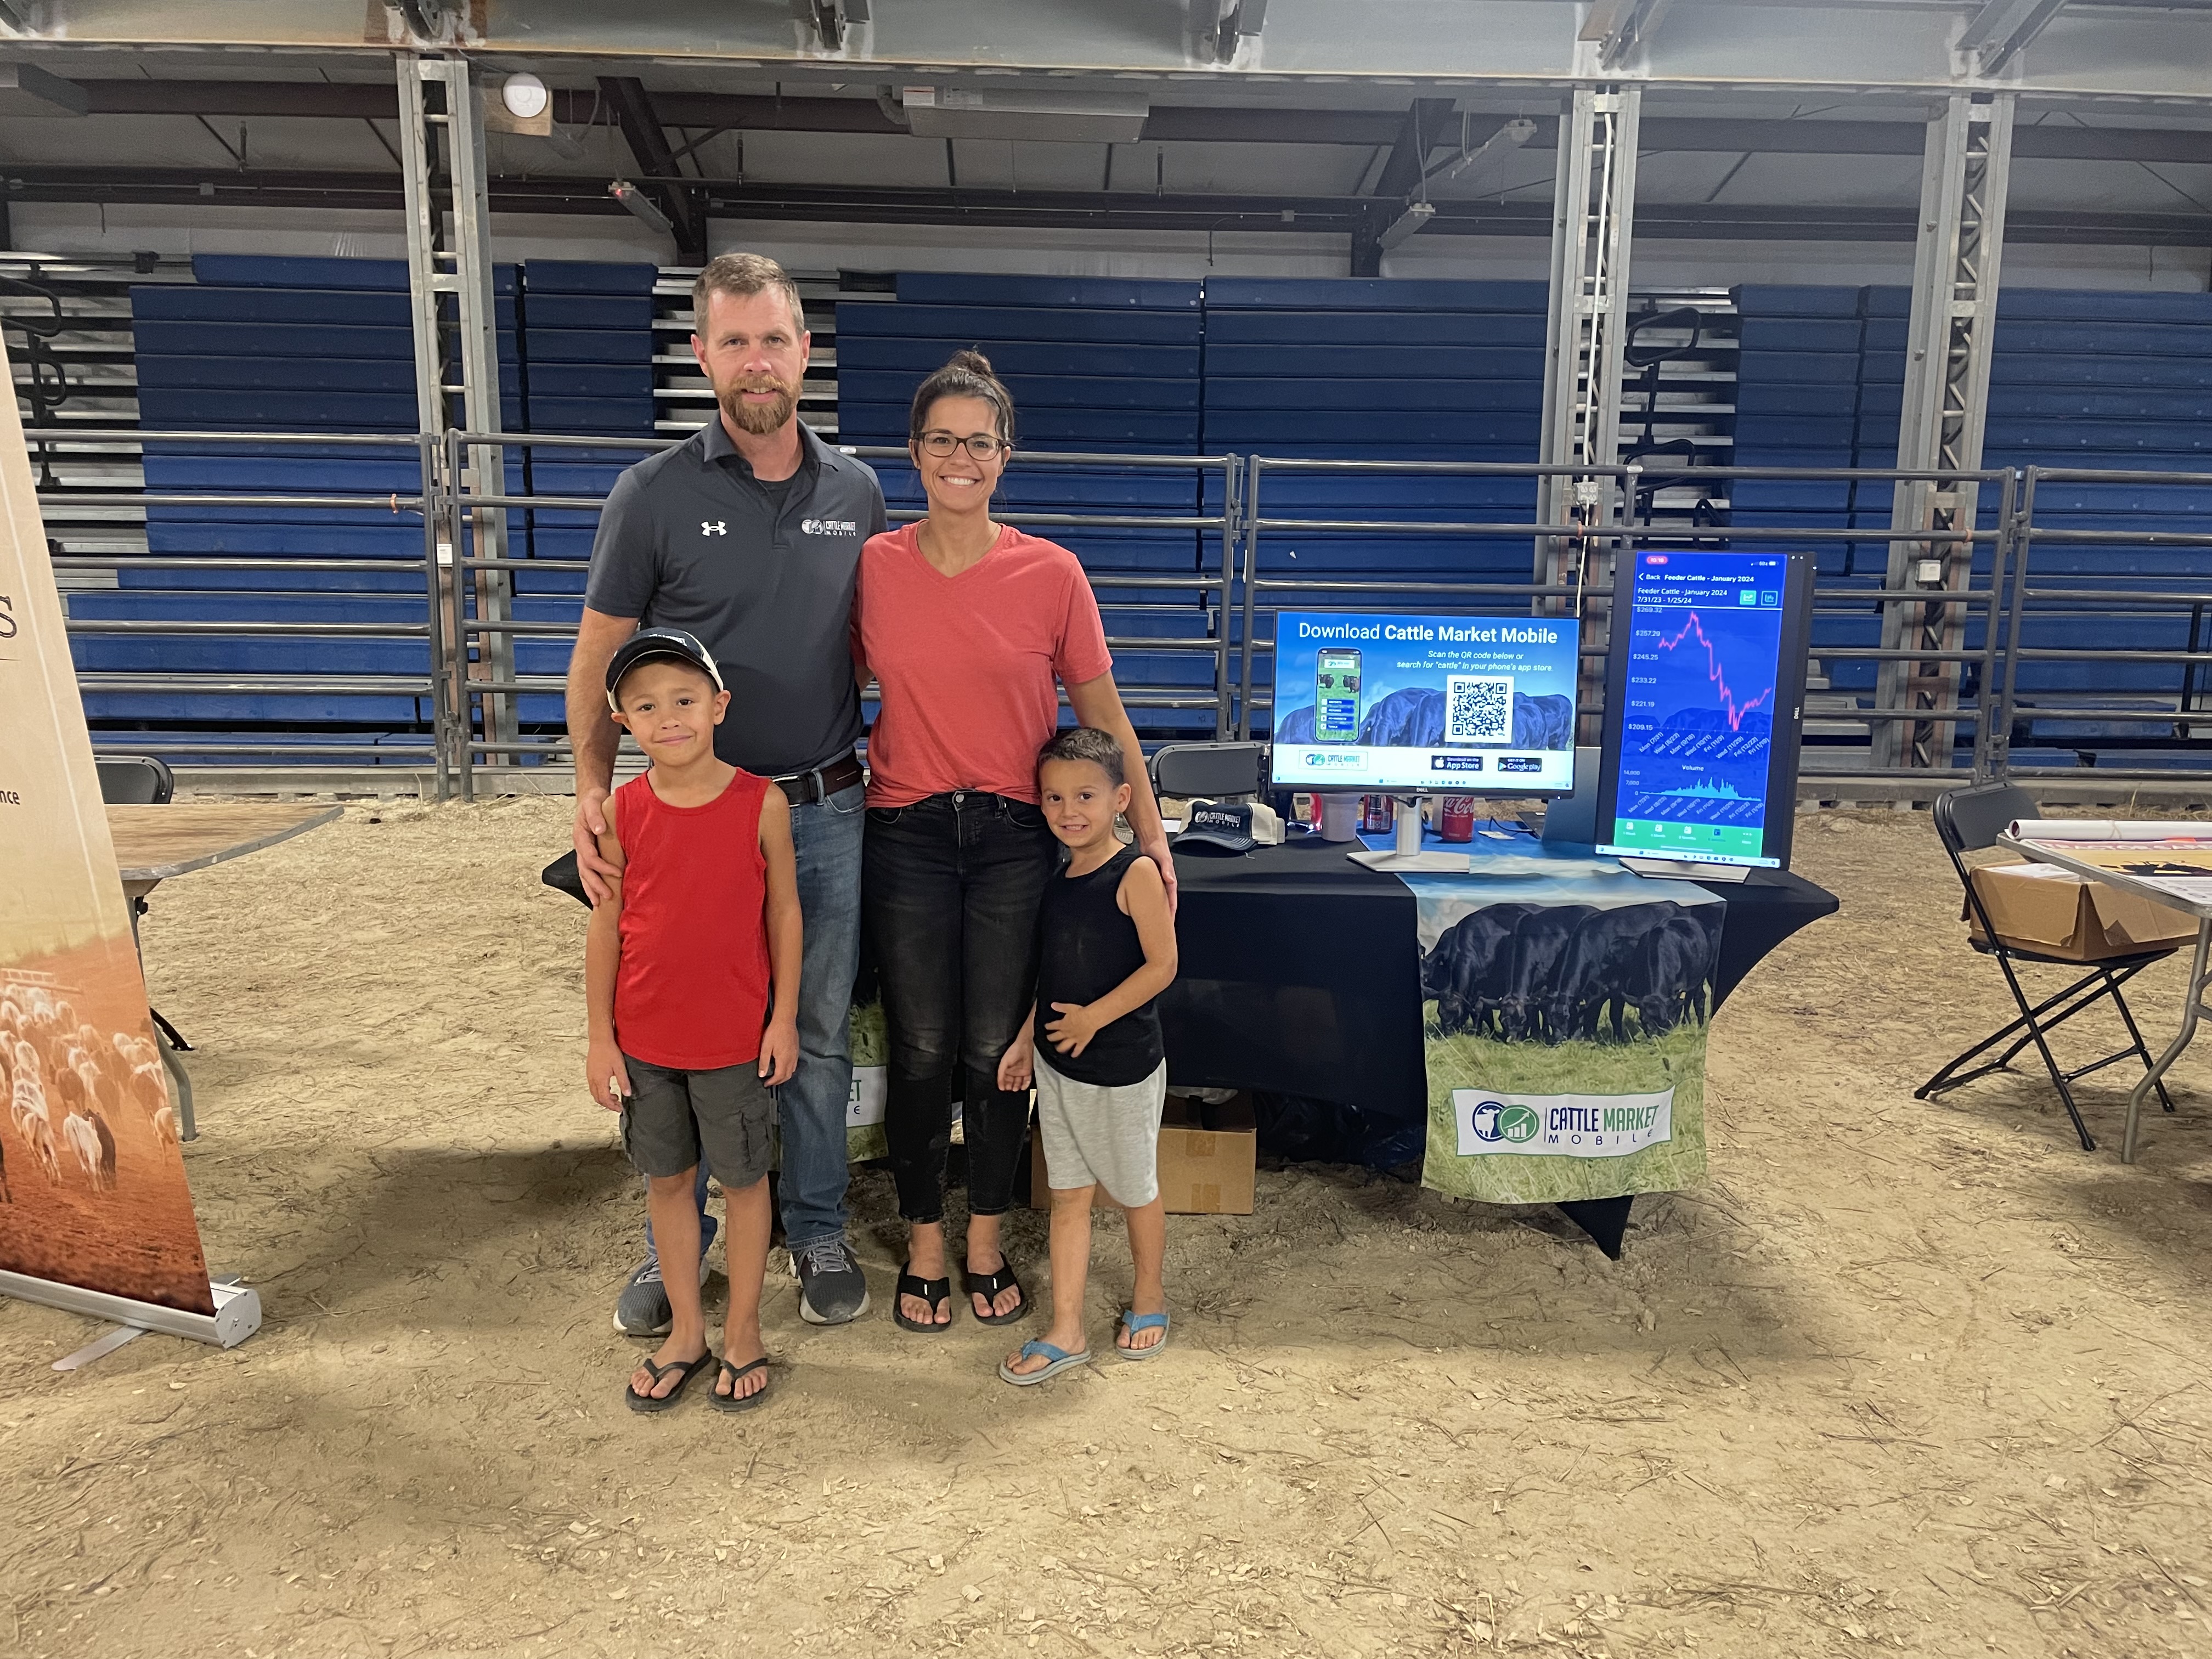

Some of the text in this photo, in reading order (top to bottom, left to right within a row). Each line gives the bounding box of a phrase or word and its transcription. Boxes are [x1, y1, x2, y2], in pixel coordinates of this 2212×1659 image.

[1684, 589, 1710, 597] January
[1299, 623, 1558, 644] Download Cattle Market Mobile
[1460, 651, 1472, 659] QR
[1487, 662, 1516, 671] phone's
[1446, 761, 1461, 770] App
[1508, 763, 1529, 771] Google
[1210, 812, 1225, 821] CATTLE
[1550, 1104, 1660, 1132] CATTLE MARKET
[1548, 1128, 1653, 1146] MOBILE
